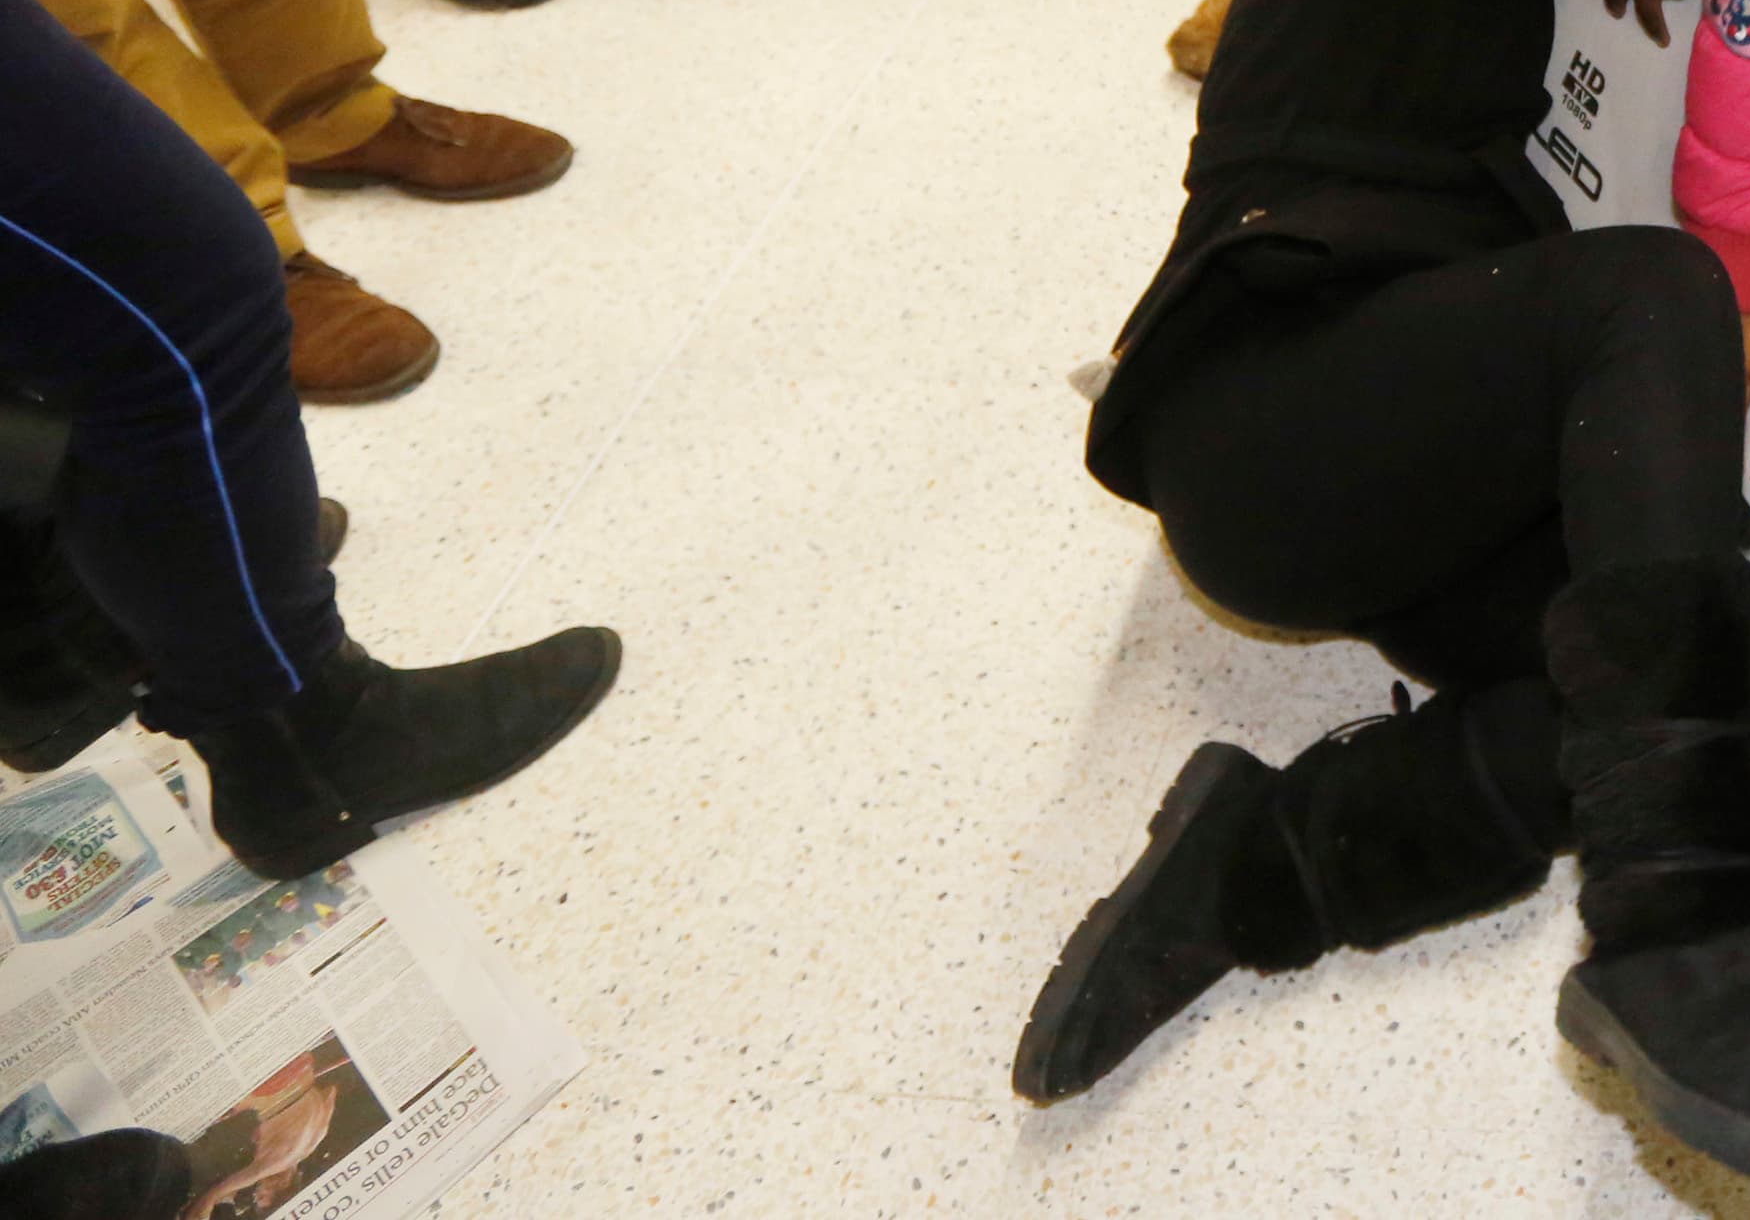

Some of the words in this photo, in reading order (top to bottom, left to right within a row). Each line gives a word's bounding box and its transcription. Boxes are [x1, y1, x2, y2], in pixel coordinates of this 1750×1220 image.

[1570, 50, 1606, 94] HD
[1560, 92, 1592, 132] 1080p
[70, 824, 119, 872] MOT
[48, 856, 122, 912] SPECIAL
[443, 1056, 488, 1100] face
[393, 1097, 443, 1141] him
[419, 1072, 500, 1148] DeGale
[361, 1146, 415, 1193] tells
[366, 1139, 390, 1166] or
